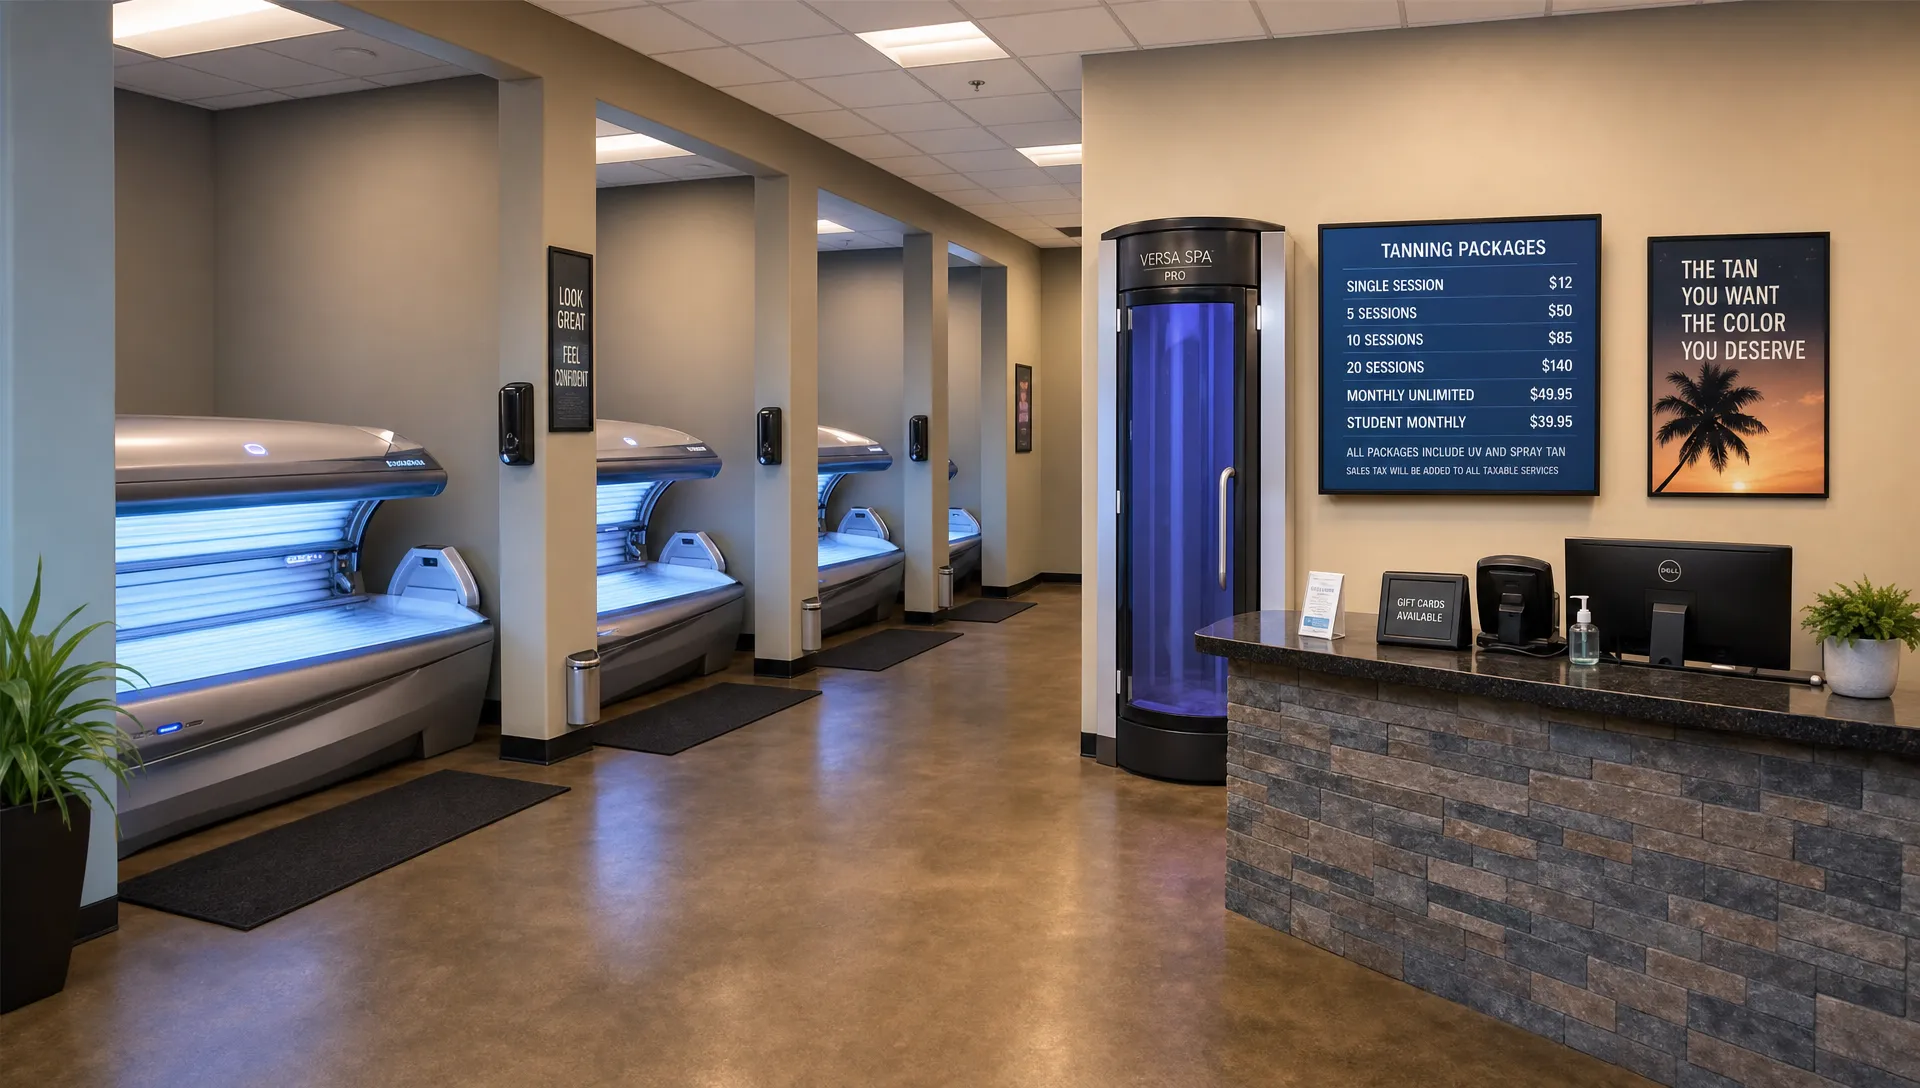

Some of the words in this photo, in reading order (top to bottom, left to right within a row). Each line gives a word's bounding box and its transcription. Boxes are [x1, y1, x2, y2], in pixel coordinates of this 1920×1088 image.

[1381, 242, 1452, 258] TANNING
[1459, 239, 1546, 257] PACKAGES
[1140, 251, 1180, 266] VERSA
[1165, 270, 1185, 281] PRO
[1682, 260, 1715, 279] THE
[1723, 259, 1758, 278] TAN
[1347, 280, 1389, 292] SINGLE
[1393, 279, 1444, 291] SESSION
[1549, 276, 1572, 290] $12
[559, 286, 583, 308] LOOK
[1682, 287, 1718, 306] YOU
[1725, 285, 1779, 305] WANT
[1347, 308, 1354, 320] 5
[1358, 306, 1417, 319] SESSIONS
[1548, 304, 1572, 318] $50
[558, 310, 585, 331] GREAT
[1682, 314, 1715, 333] THE
[1723, 312, 1785, 332] COLOR
[1347, 334, 1360, 346] 10
[1364, 333, 1423, 346] SESSIONS
[1548, 331, 1572, 345] $85
[563, 345, 580, 364] FEEL
[1682, 341, 1718, 360] YOU
[1725, 340, 1805, 360] DESERVE
[1347, 361, 1361, 374] 20
[1366, 361, 1424, 373] SESSIONS
[1542, 358, 1572, 372] $140
[1347, 389, 1404, 402] MONTHLY
[1408, 388, 1474, 401] UNLIMITED
[1530, 387, 1572, 401] $49.95
[1347, 416, 1402, 428] STUDENT
[1407, 416, 1466, 428] MONTHLY
[1530, 414, 1572, 428] $39.95
[1347, 447, 1364, 458] ALL
[1368, 447, 1418, 457] PACKAGES
[1422, 447, 1464, 457] INCLUDE
[1468, 447, 1482, 457] UV
[1485, 447, 1506, 457] AND
[1510, 446, 1543, 457] SPRAY
[1546, 446, 1566, 457] TAN
[1346, 467, 1370, 475] SALES
[1373, 467, 1387, 475] TAX
[1390, 467, 1408, 475] WILL
[1411, 467, 1420, 475] BE
[1423, 467, 1450, 475] ADDED
[1453, 467, 1463, 475] TO
[1466, 466, 1480, 475] ALL
[1483, 466, 1518, 475] TAXABLE
[1521, 466, 1558, 475] SERVICES
[1397, 598, 1415, 607] GIFT
[1417, 599, 1445, 608] CARDS
[1397, 611, 1442, 622] AVAILABLE
